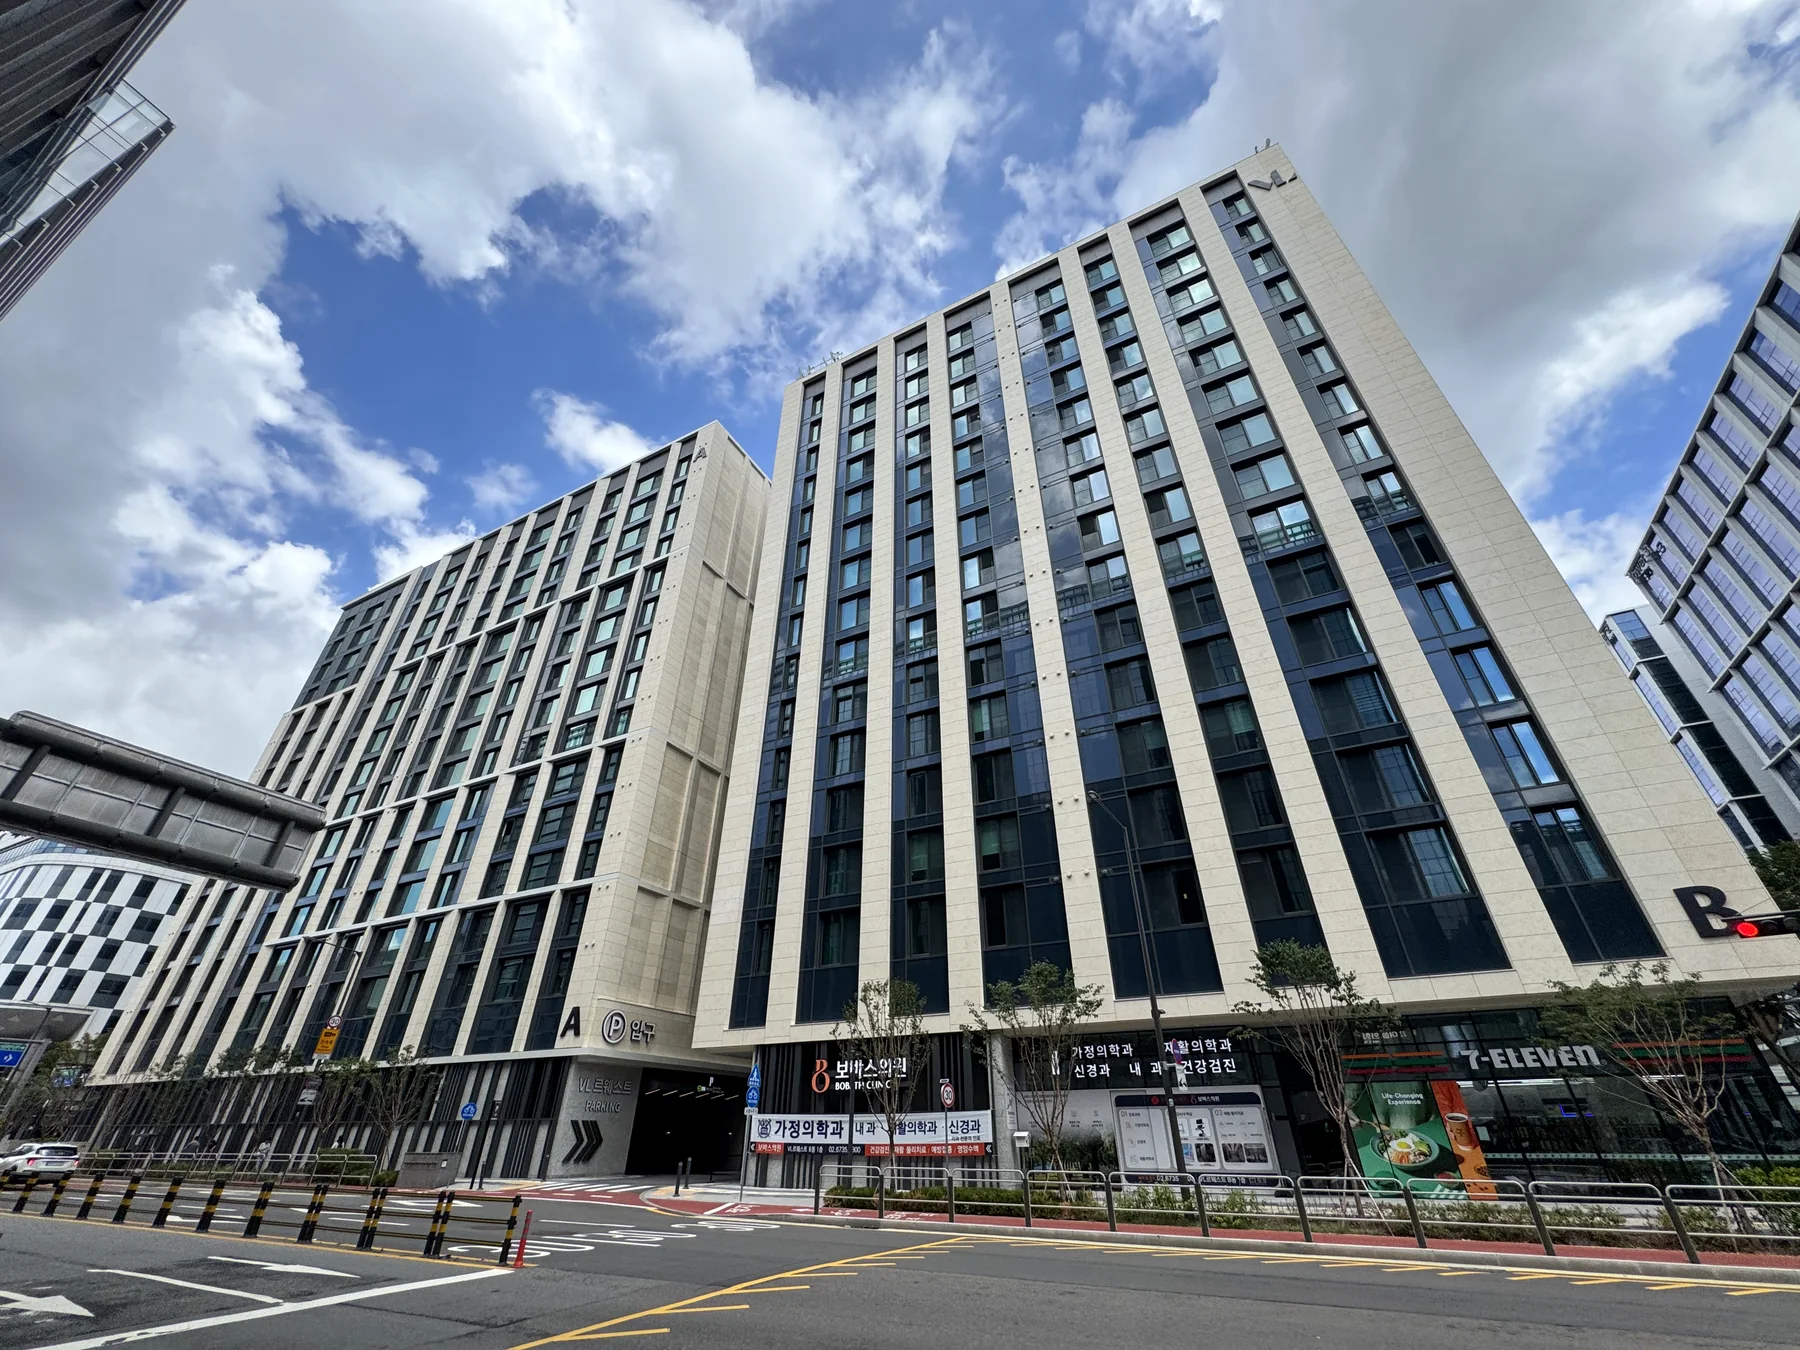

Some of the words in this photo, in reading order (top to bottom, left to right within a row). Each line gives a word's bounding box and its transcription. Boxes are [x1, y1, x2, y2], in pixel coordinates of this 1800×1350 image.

[693, 447, 707, 463] A
[1673, 885, 1742, 938] B
[560, 1006, 581, 1038] A
[608, 1015, 622, 1037] P
[630, 1020, 656, 1042] 입구
[1072, 1043, 1133, 1060] 가정의학과
[835, 1057, 907, 1079] 보바스의원
[1074, 1063, 1110, 1079] 신경과
[1182, 1058, 1237, 1075] 건강검진
[593, 1078, 633, 1095] 르웨스트
[835, 1081, 865, 1091] BOBTH
[866, 1079, 891, 1090] CLINC
[944, 1091, 952, 1101] 30
[1387, 1098, 1421, 1106] Experience
[585, 1100, 621, 1114] PARKING
[1214, 1109, 1223, 1117] 03
[776, 1120, 844, 1139] 가정의학과
[893, 1120, 937, 1136] 활의학과
[949, 1119, 981, 1134] 신경과
[870, 1145, 889, 1154] 건강검진
